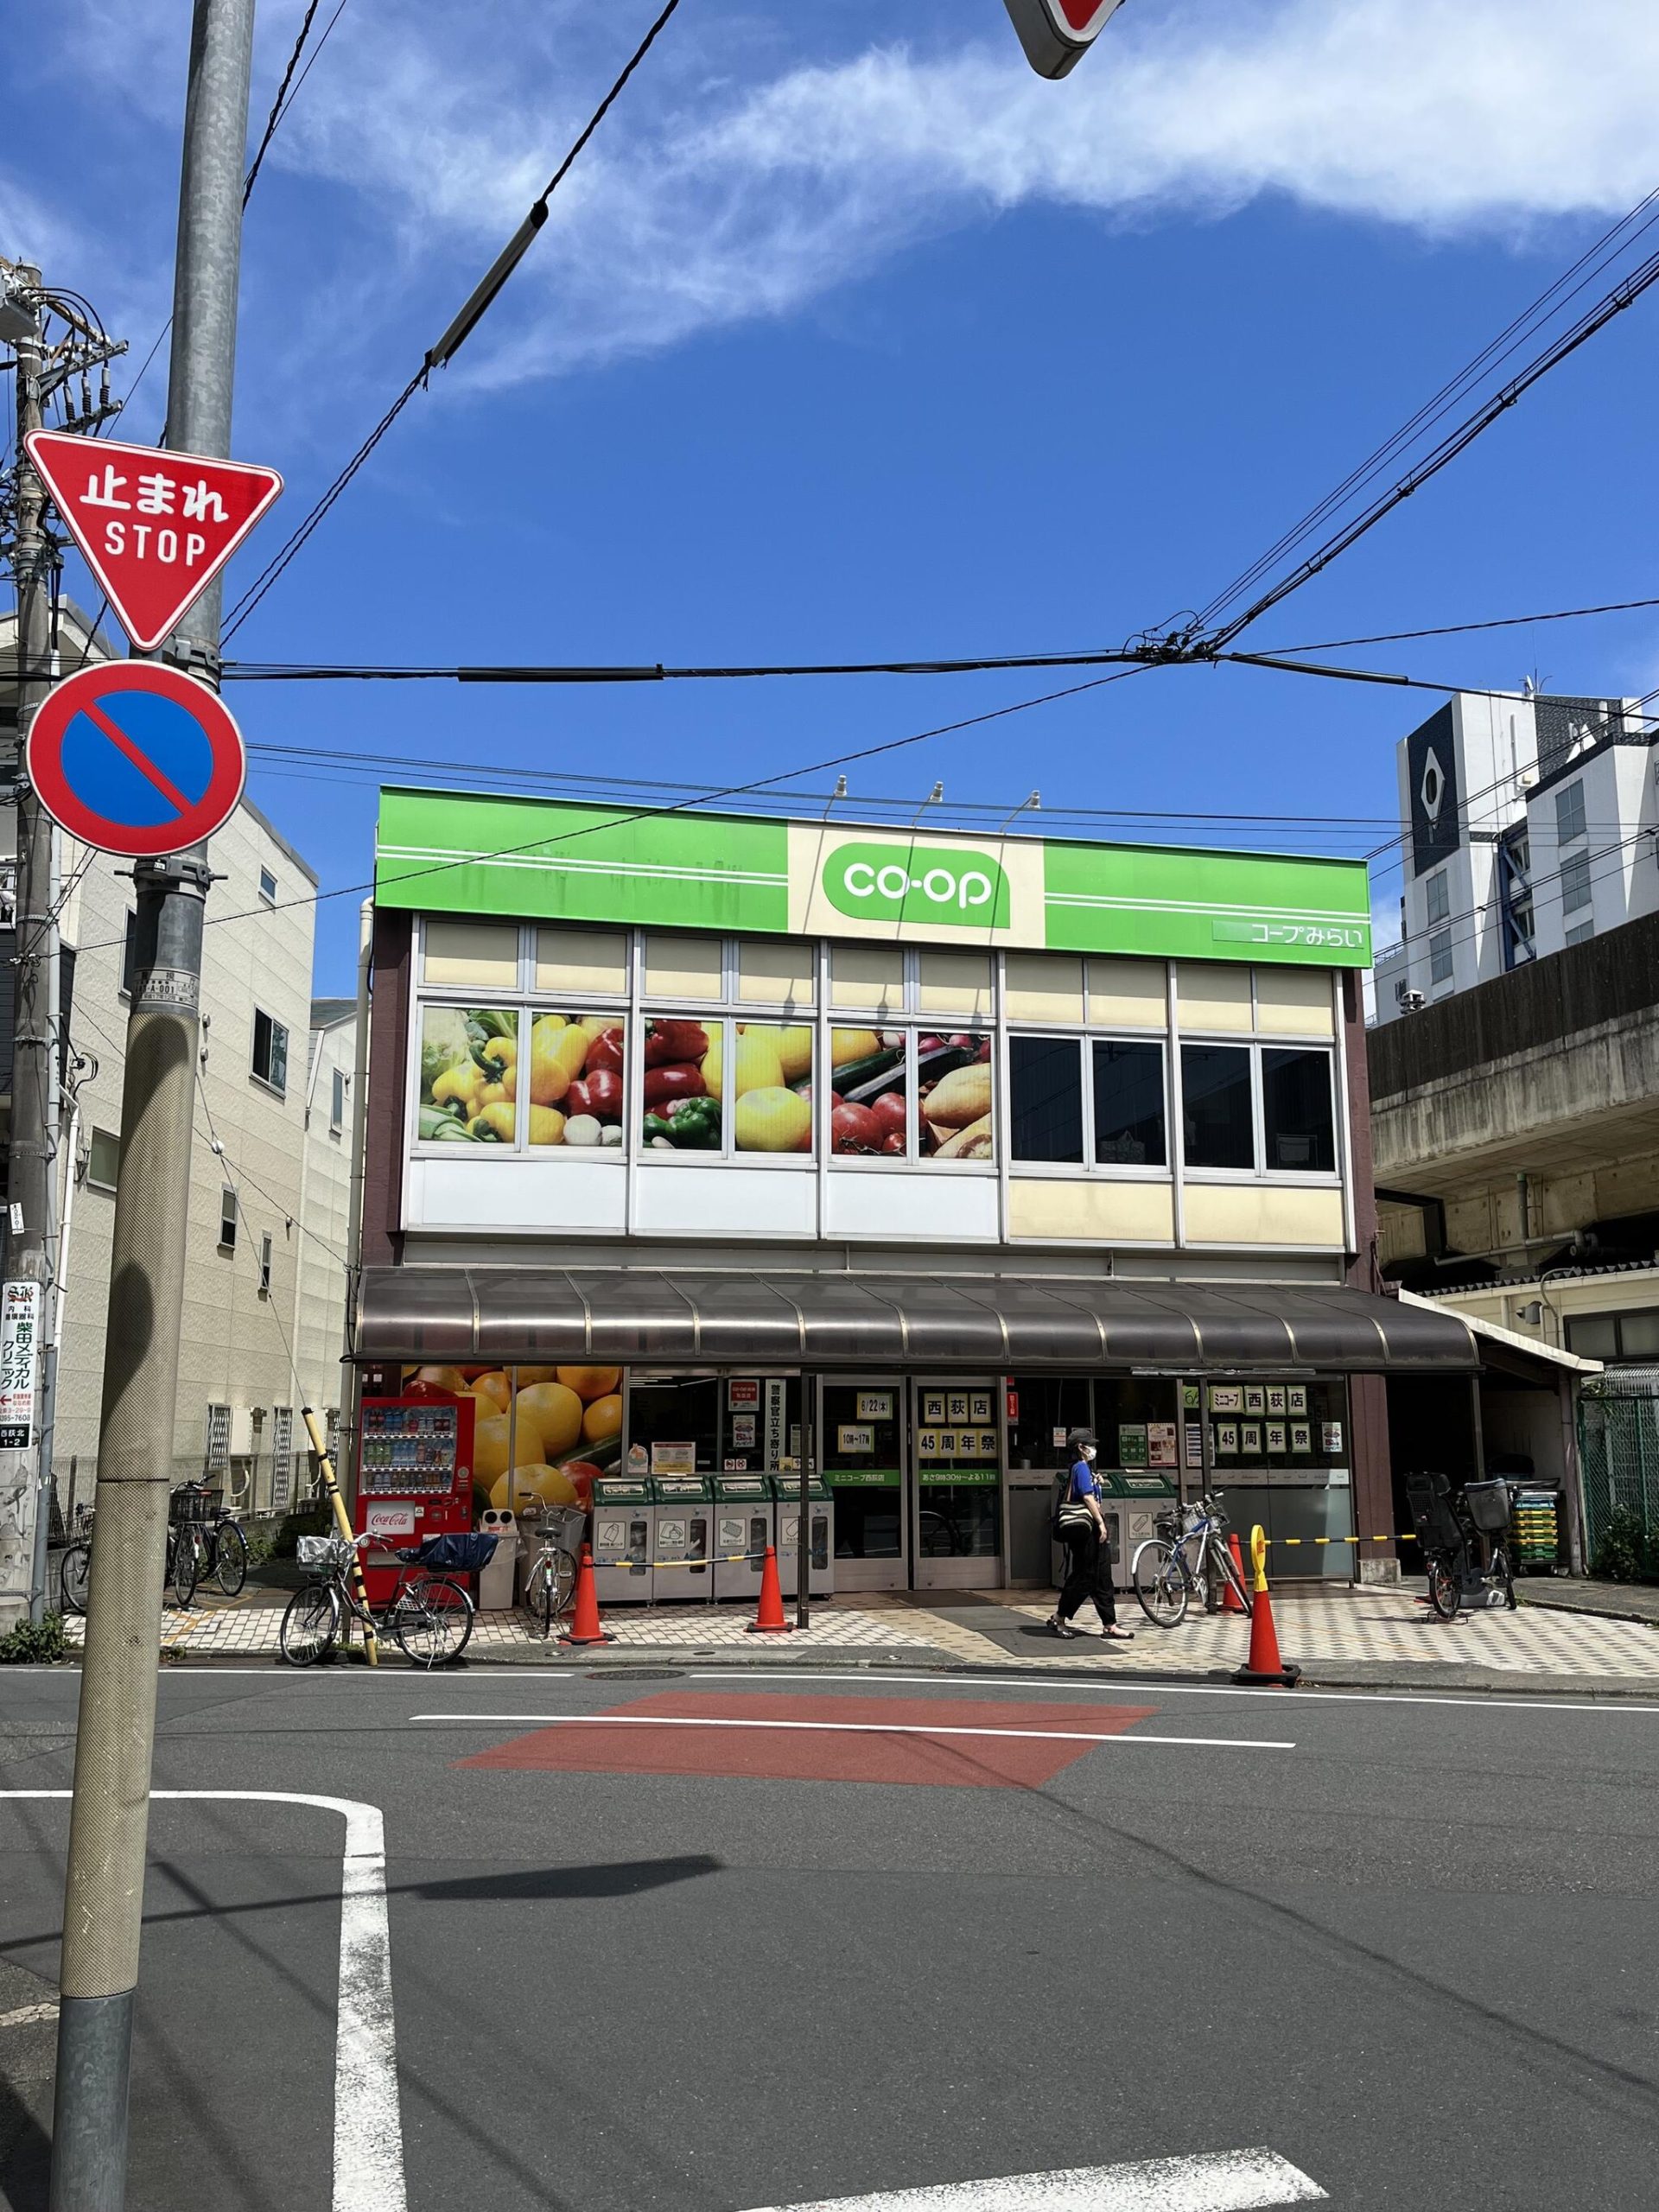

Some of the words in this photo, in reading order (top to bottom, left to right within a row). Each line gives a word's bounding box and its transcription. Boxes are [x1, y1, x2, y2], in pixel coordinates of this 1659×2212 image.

[79, 464, 229, 522] 止まれ
[105, 521, 206, 566] STOP
[1251, 924, 1363, 947] コープみらい
[2, 1340, 15, 1389] クリニック
[14, 1322, 33, 1389] 柴田メディカル
[928, 1399, 988, 1415] 西荻店
[3, 1438, 21, 1446] 1-2
[770, 1384, 781, 1471] 警察官立ち寄り所
[921, 1435, 995, 1450] 45周年祭
[1222, 1430, 1308, 1445] 45周年祭
